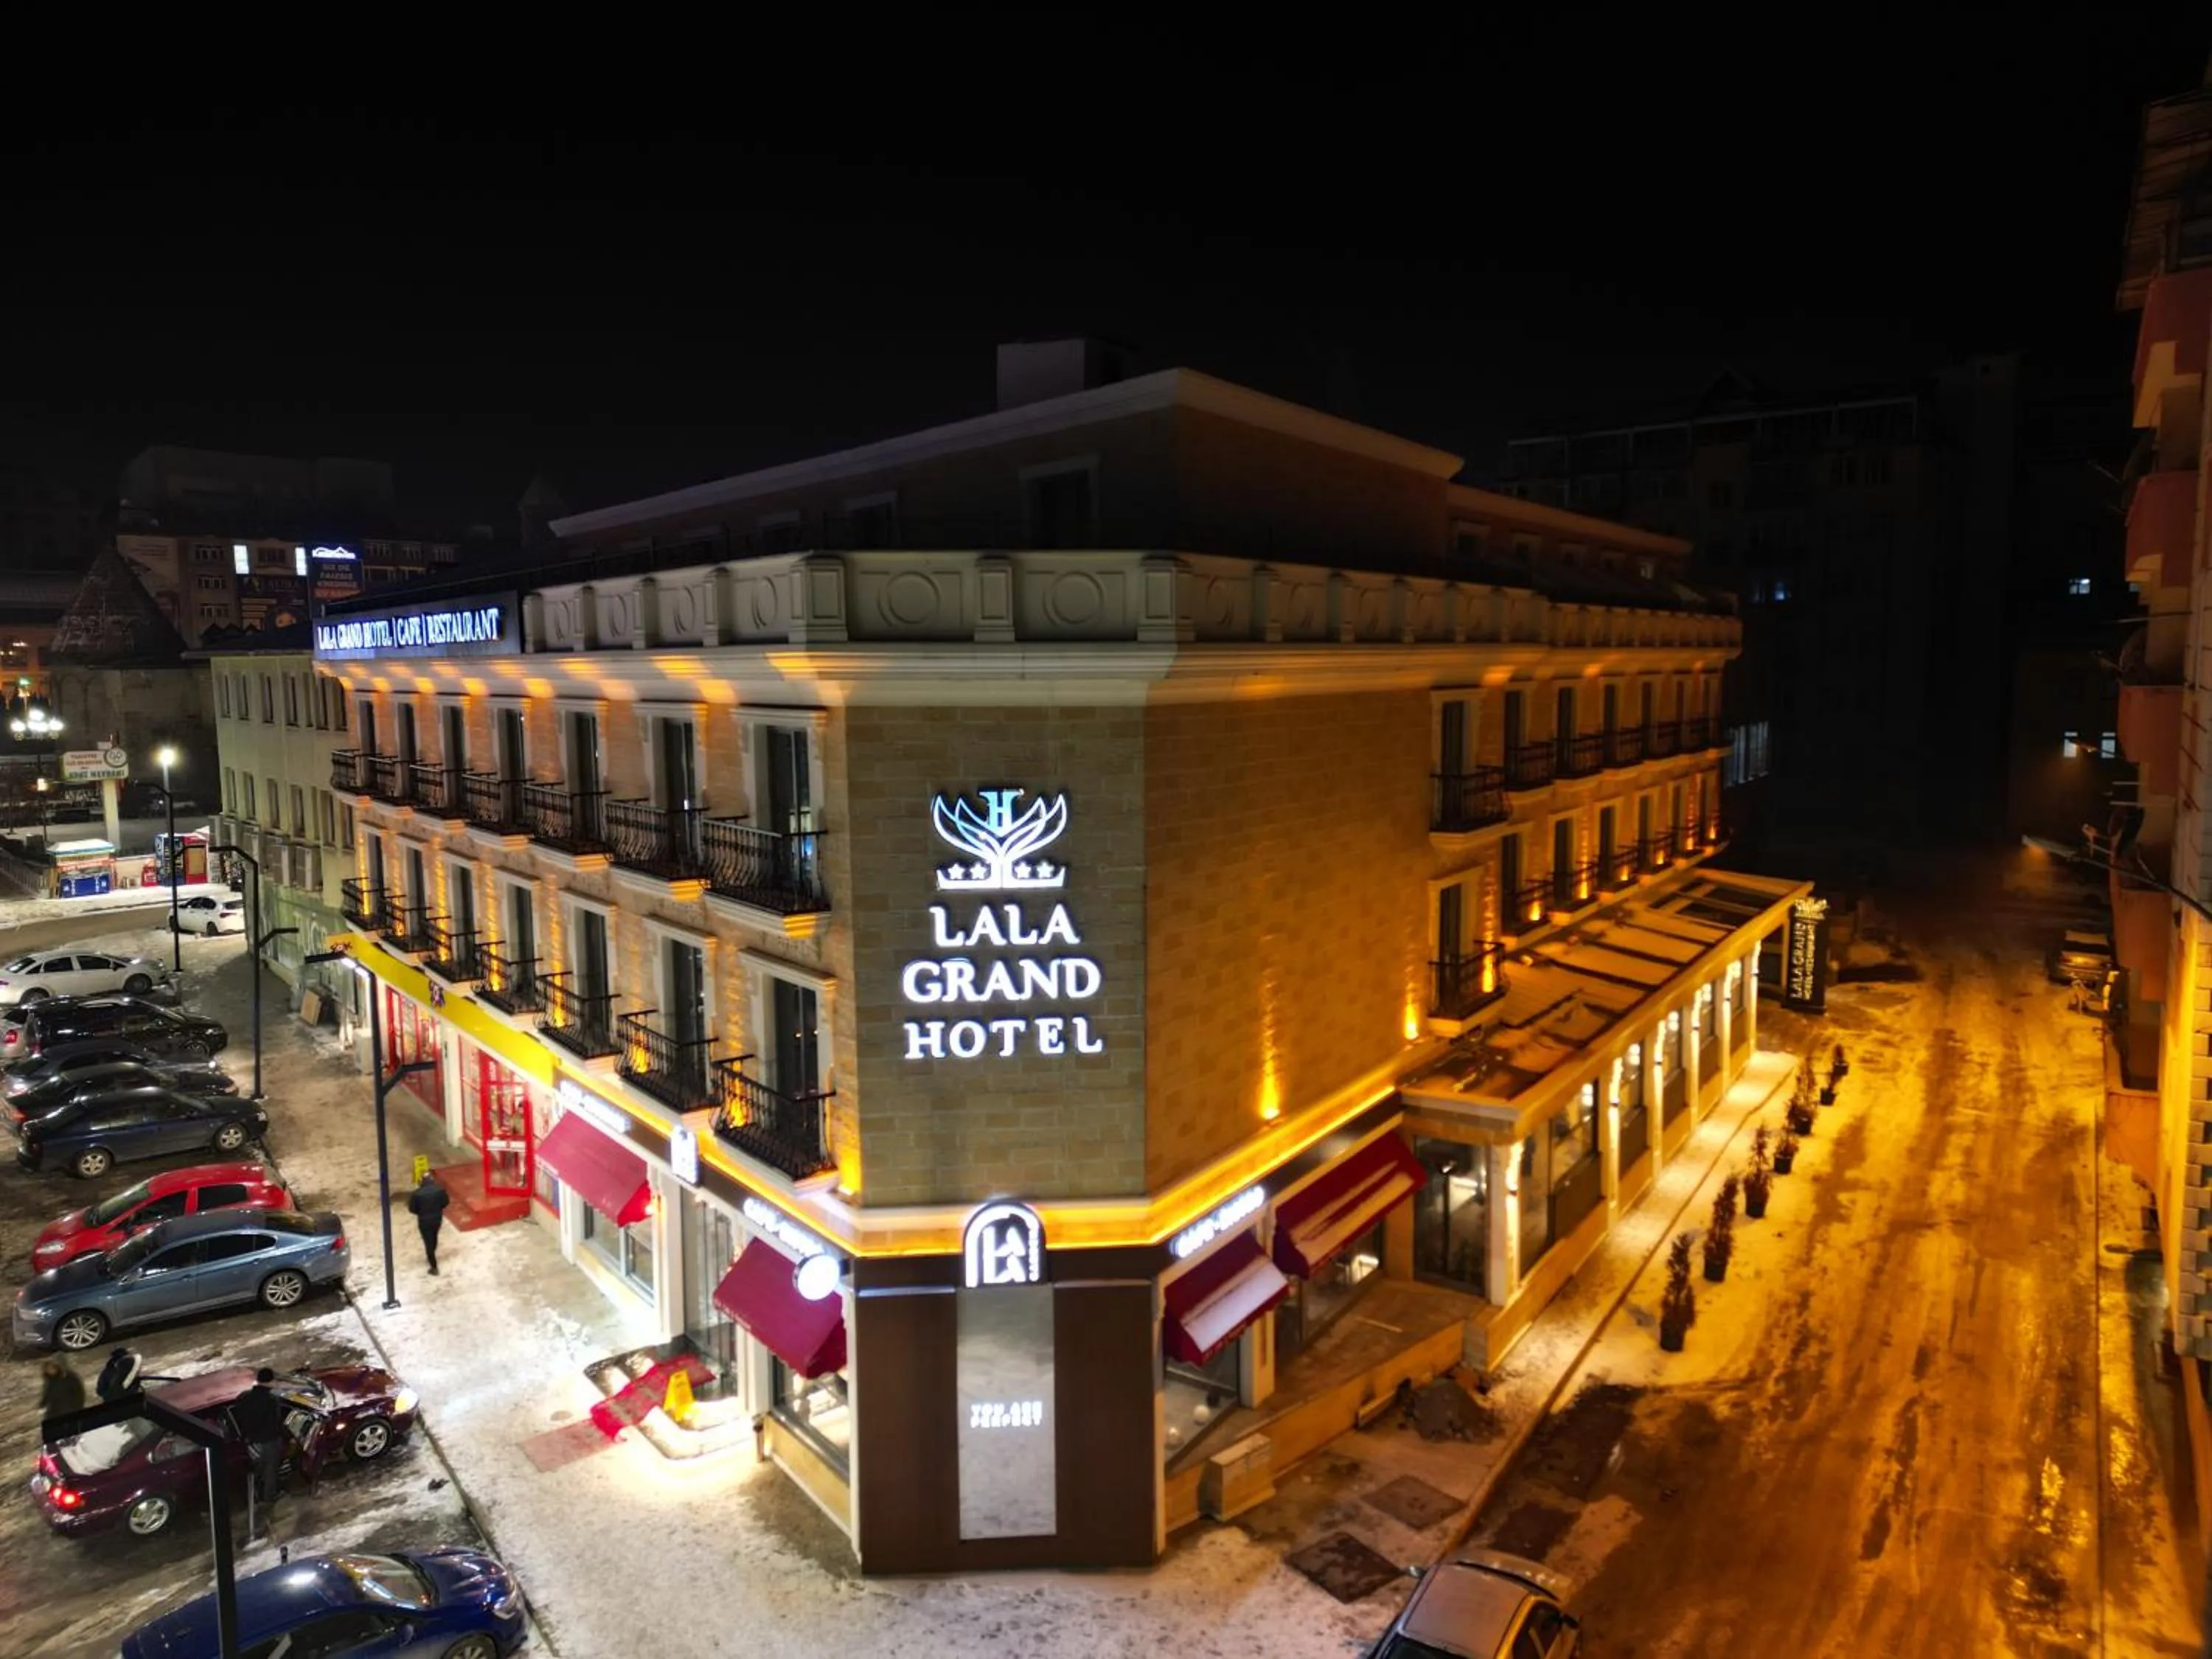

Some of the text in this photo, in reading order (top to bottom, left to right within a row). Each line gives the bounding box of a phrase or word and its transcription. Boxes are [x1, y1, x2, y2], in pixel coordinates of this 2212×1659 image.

[363, 620, 393, 648] HOTEL
[397, 616, 422, 646] CAFE
[427, 608, 499, 644] RESTAURANT
[929, 903, 1080, 947] LALA
[902, 957, 1102, 1002] GRAND
[904, 1017, 1103, 1060] HOTEL
